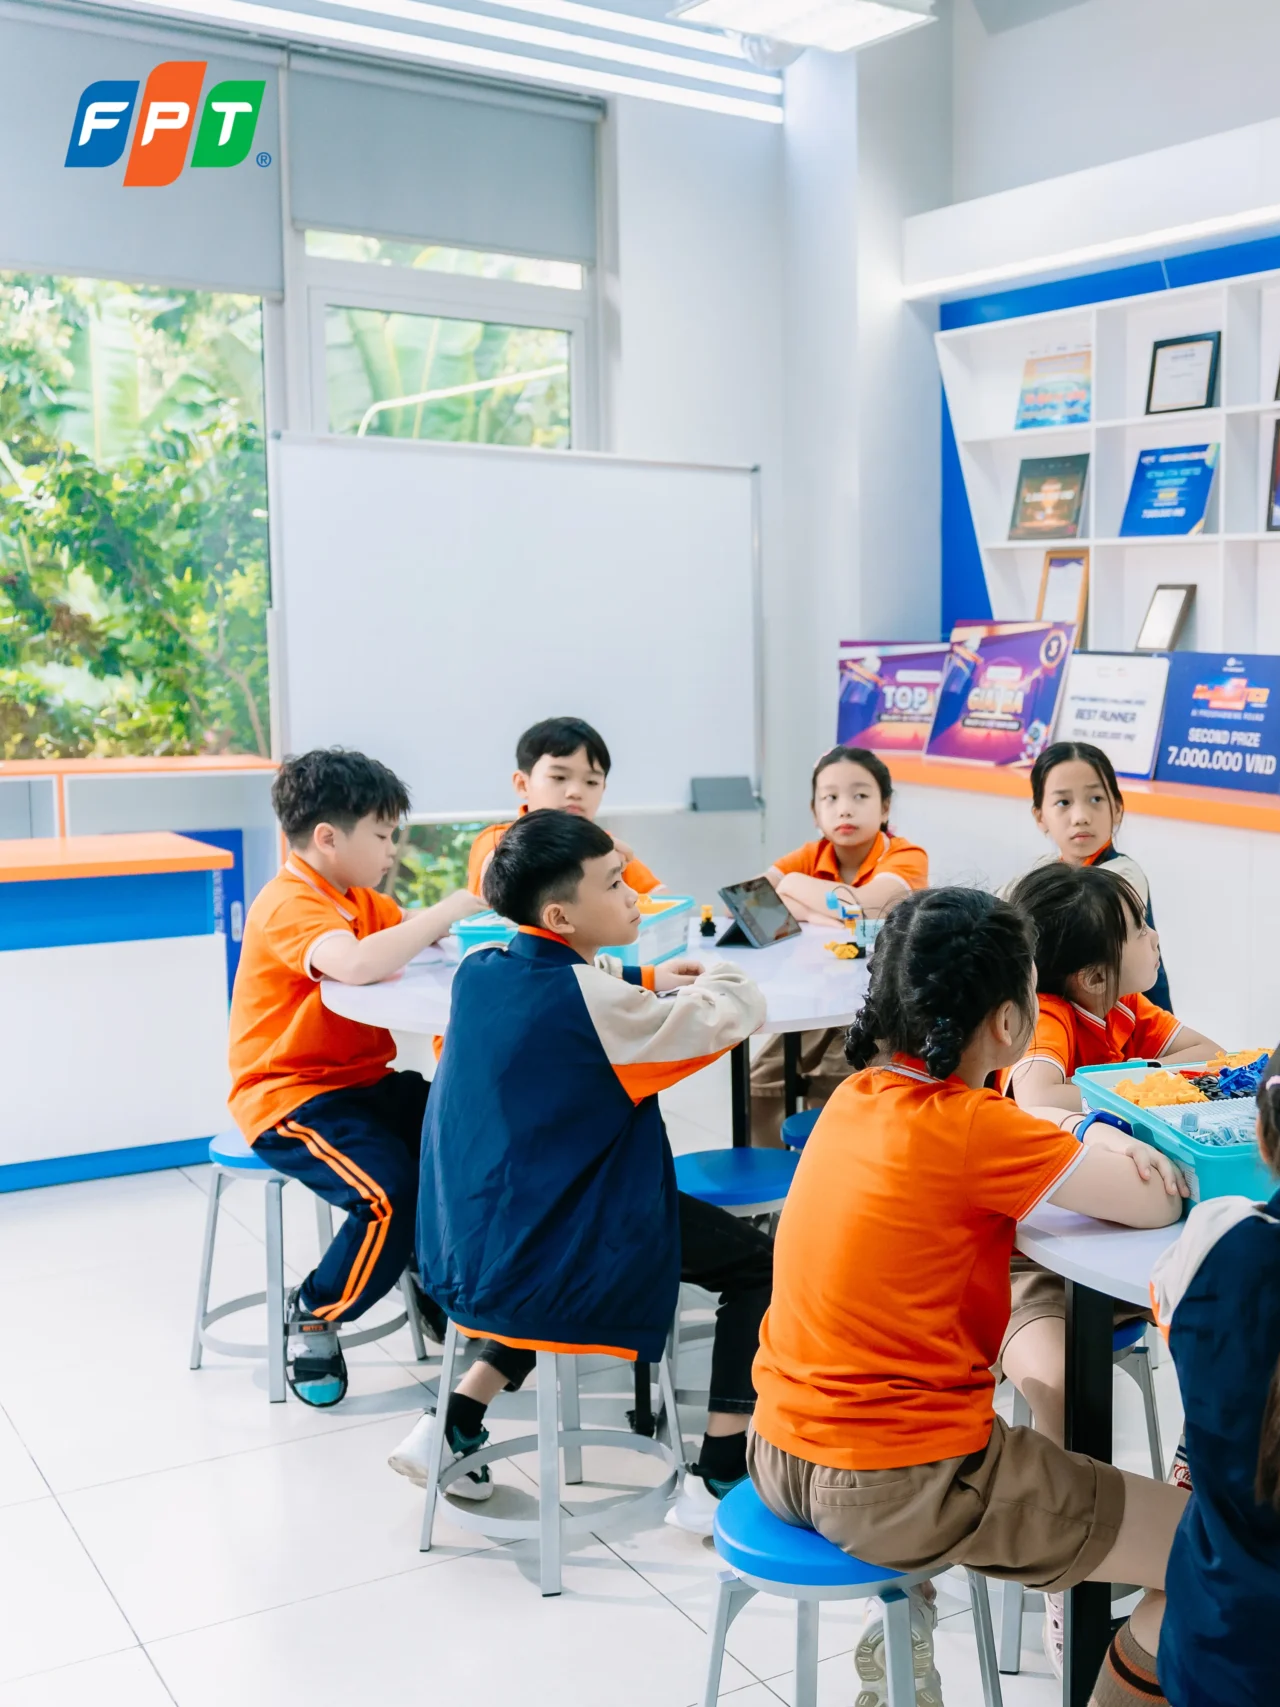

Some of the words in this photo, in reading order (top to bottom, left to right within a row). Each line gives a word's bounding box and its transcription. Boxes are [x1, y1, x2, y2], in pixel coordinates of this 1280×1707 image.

[882, 686, 928, 710] TOP
[1075, 708, 1098, 721] BEST
[1099, 710, 1137, 724] RUNNER
[1188, 727, 1230, 745] SECOND
[1230, 731, 1262, 748] PRIZE
[1167, 745, 1243, 772] 7.000.000
[1245, 753, 1277, 776] VND
